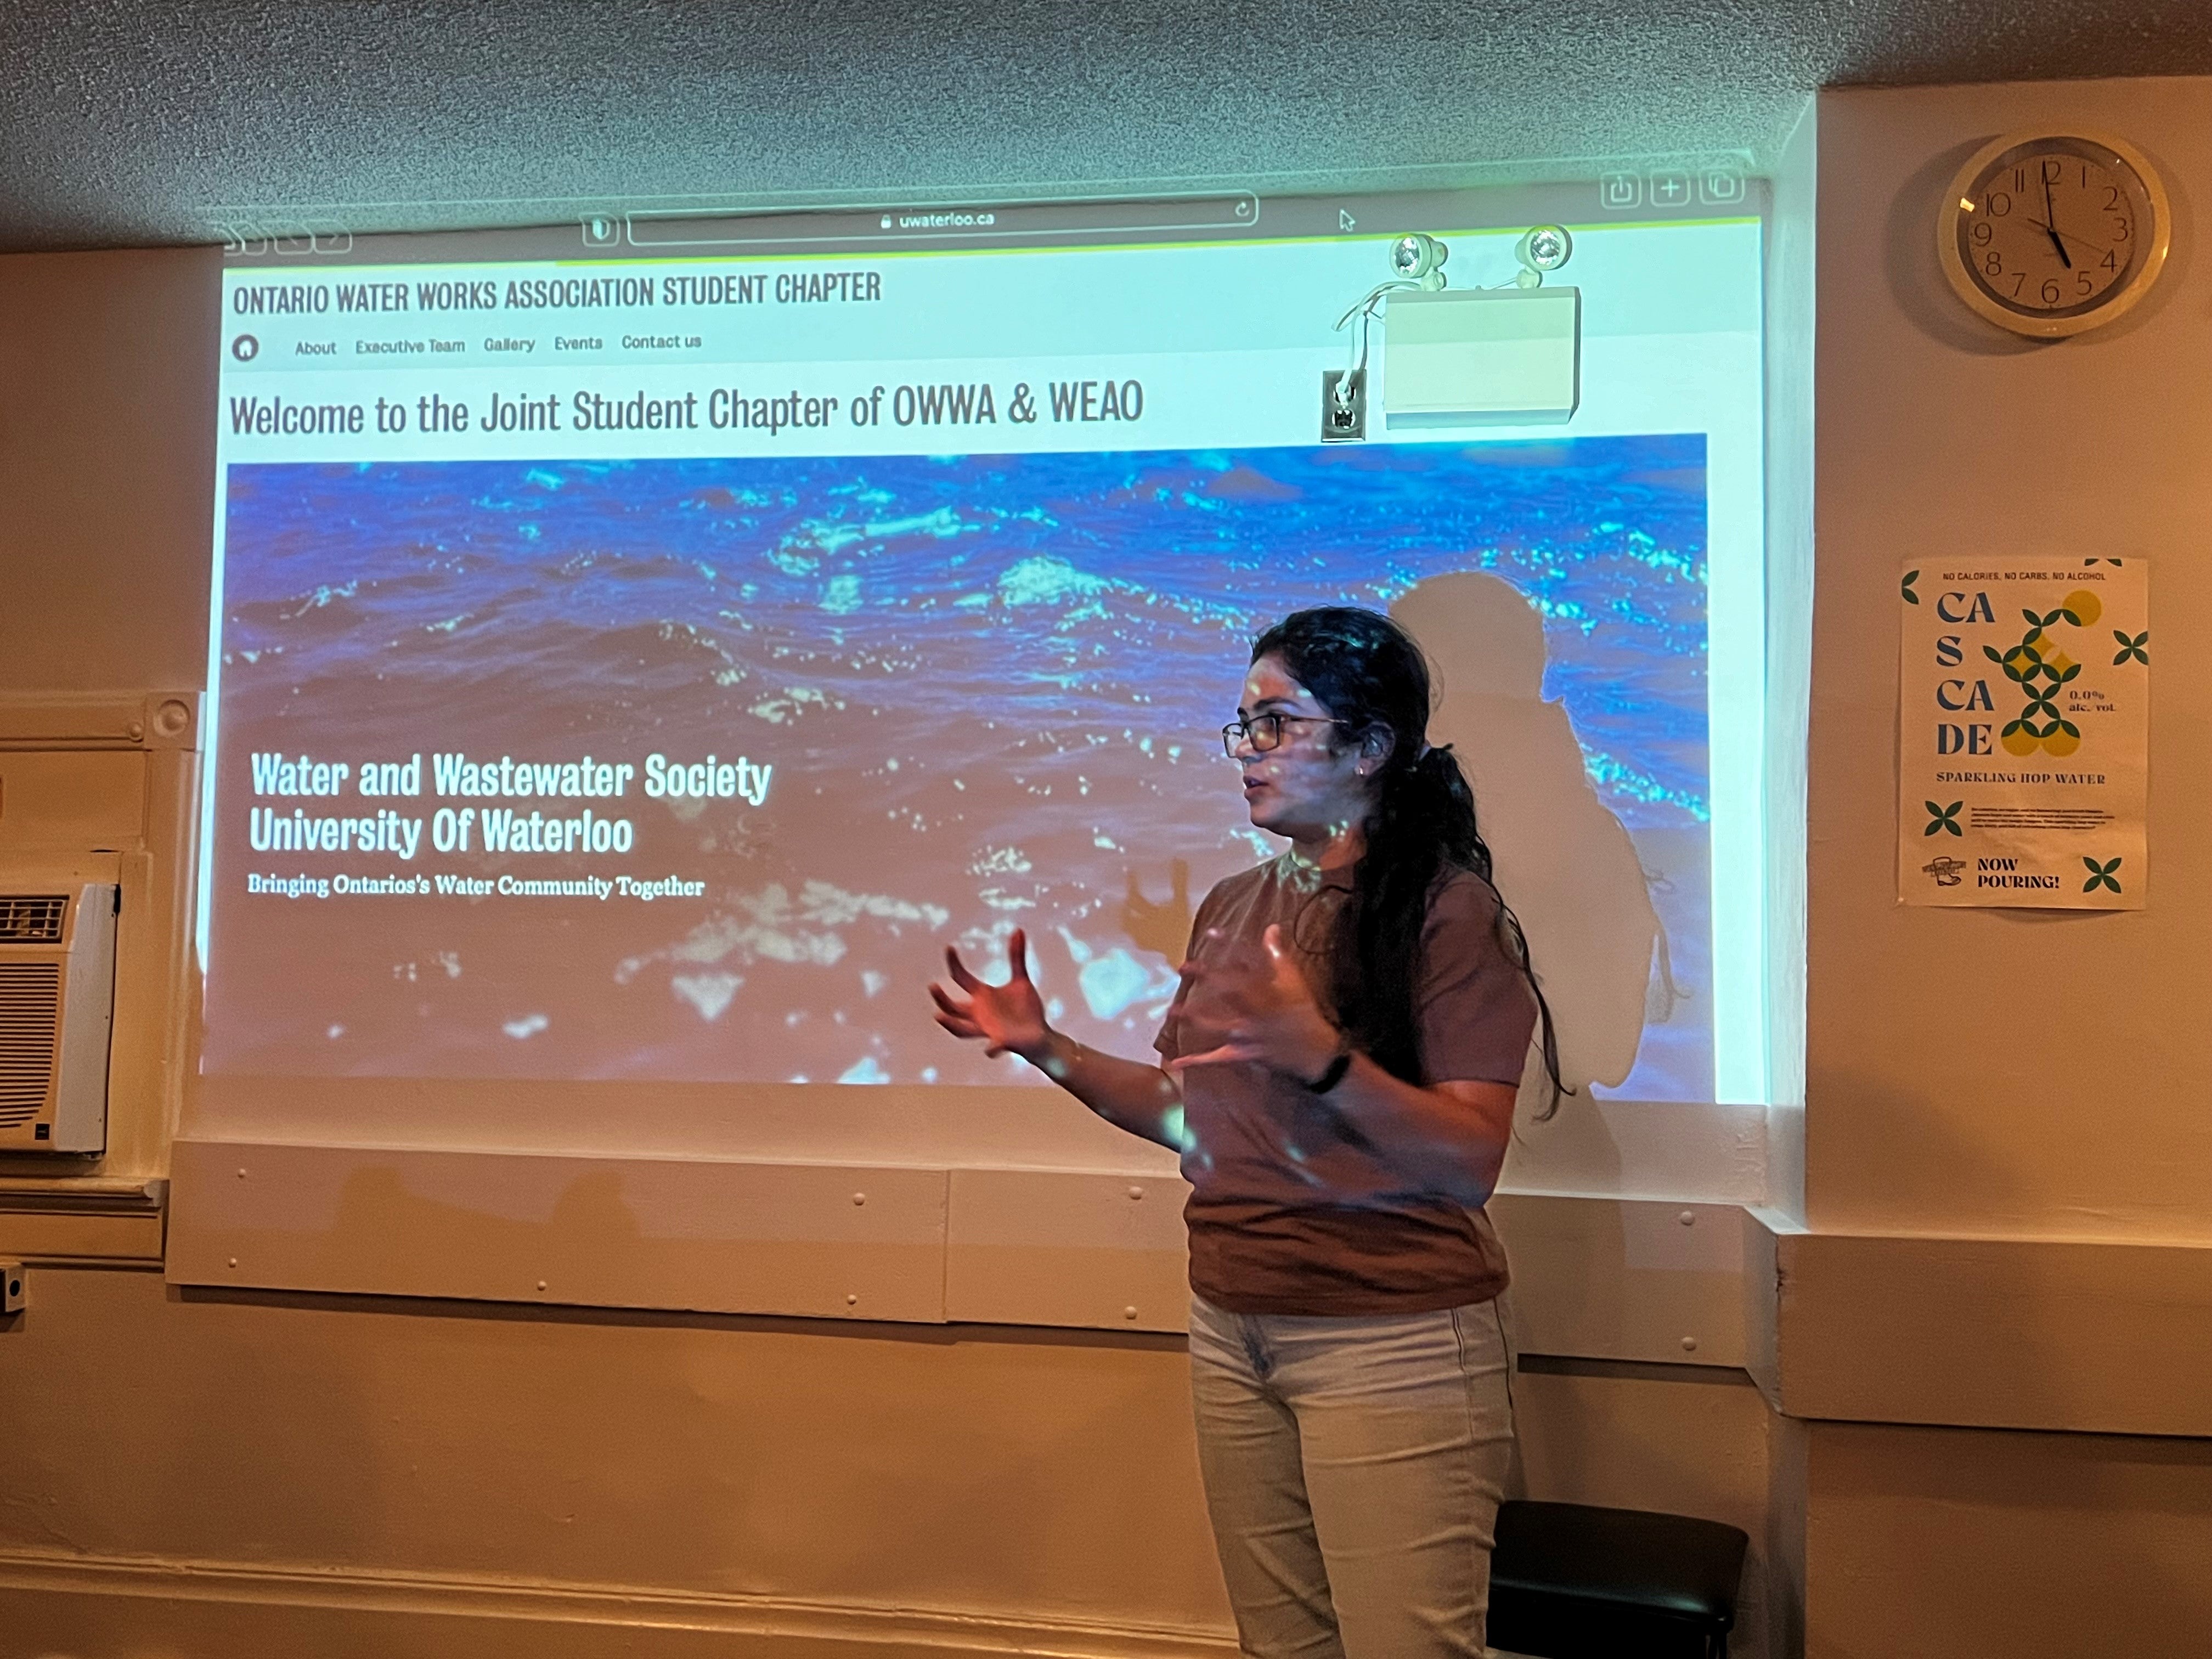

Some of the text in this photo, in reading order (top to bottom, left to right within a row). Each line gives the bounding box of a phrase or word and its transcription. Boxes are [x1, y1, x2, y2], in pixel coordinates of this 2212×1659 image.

[2016, 169, 2024, 193] 11
[2042, 160, 2061, 184] 12
[1986, 193, 2011, 217] 10
[2103, 187, 2118, 211] 2
[899, 212, 995, 228] uwaterloo.ca
[2113, 217, 2128, 241] 3
[1974, 222, 1992, 247] 9
[1985, 252, 2002, 276] 8
[2100, 249, 2118, 273] 4
[233, 272, 882, 315] ONTARIO WATER WORKS ASSOCIATION STUDENT CHAPTER
[2012, 273, 2026, 297] 7
[2041, 278, 2059, 304] 6
[2076, 270, 2092, 295] 5
[295, 334, 702, 356] About Executive Team Gallery Events Contact us
[230, 380, 1143, 436] Welcome to the Joint Student Chapter of OWWA & WEAO
[1943, 572, 1955, 580] NO
[2052, 572, 2065, 580] NO
[2067, 572, 2106, 580] ALCOHOL
[1937, 592, 1995, 623] CA
[1936, 636, 1963, 667] S
[1937, 680, 1995, 710] CA
[2069, 703, 2090, 712] alc.
[1937, 724, 1993, 755] DE
[251, 752, 772, 806] Water and Wastewater Society
[1936, 772, 2105, 785] SPARKLING HOP WATER
[249, 807, 633, 860] University Of Waterloo
[1978, 858, 2018, 871] NOW
[247, 873, 706, 901] Bringing Ontarios's Water Community Together
[1978, 875, 2059, 889] POURING!
